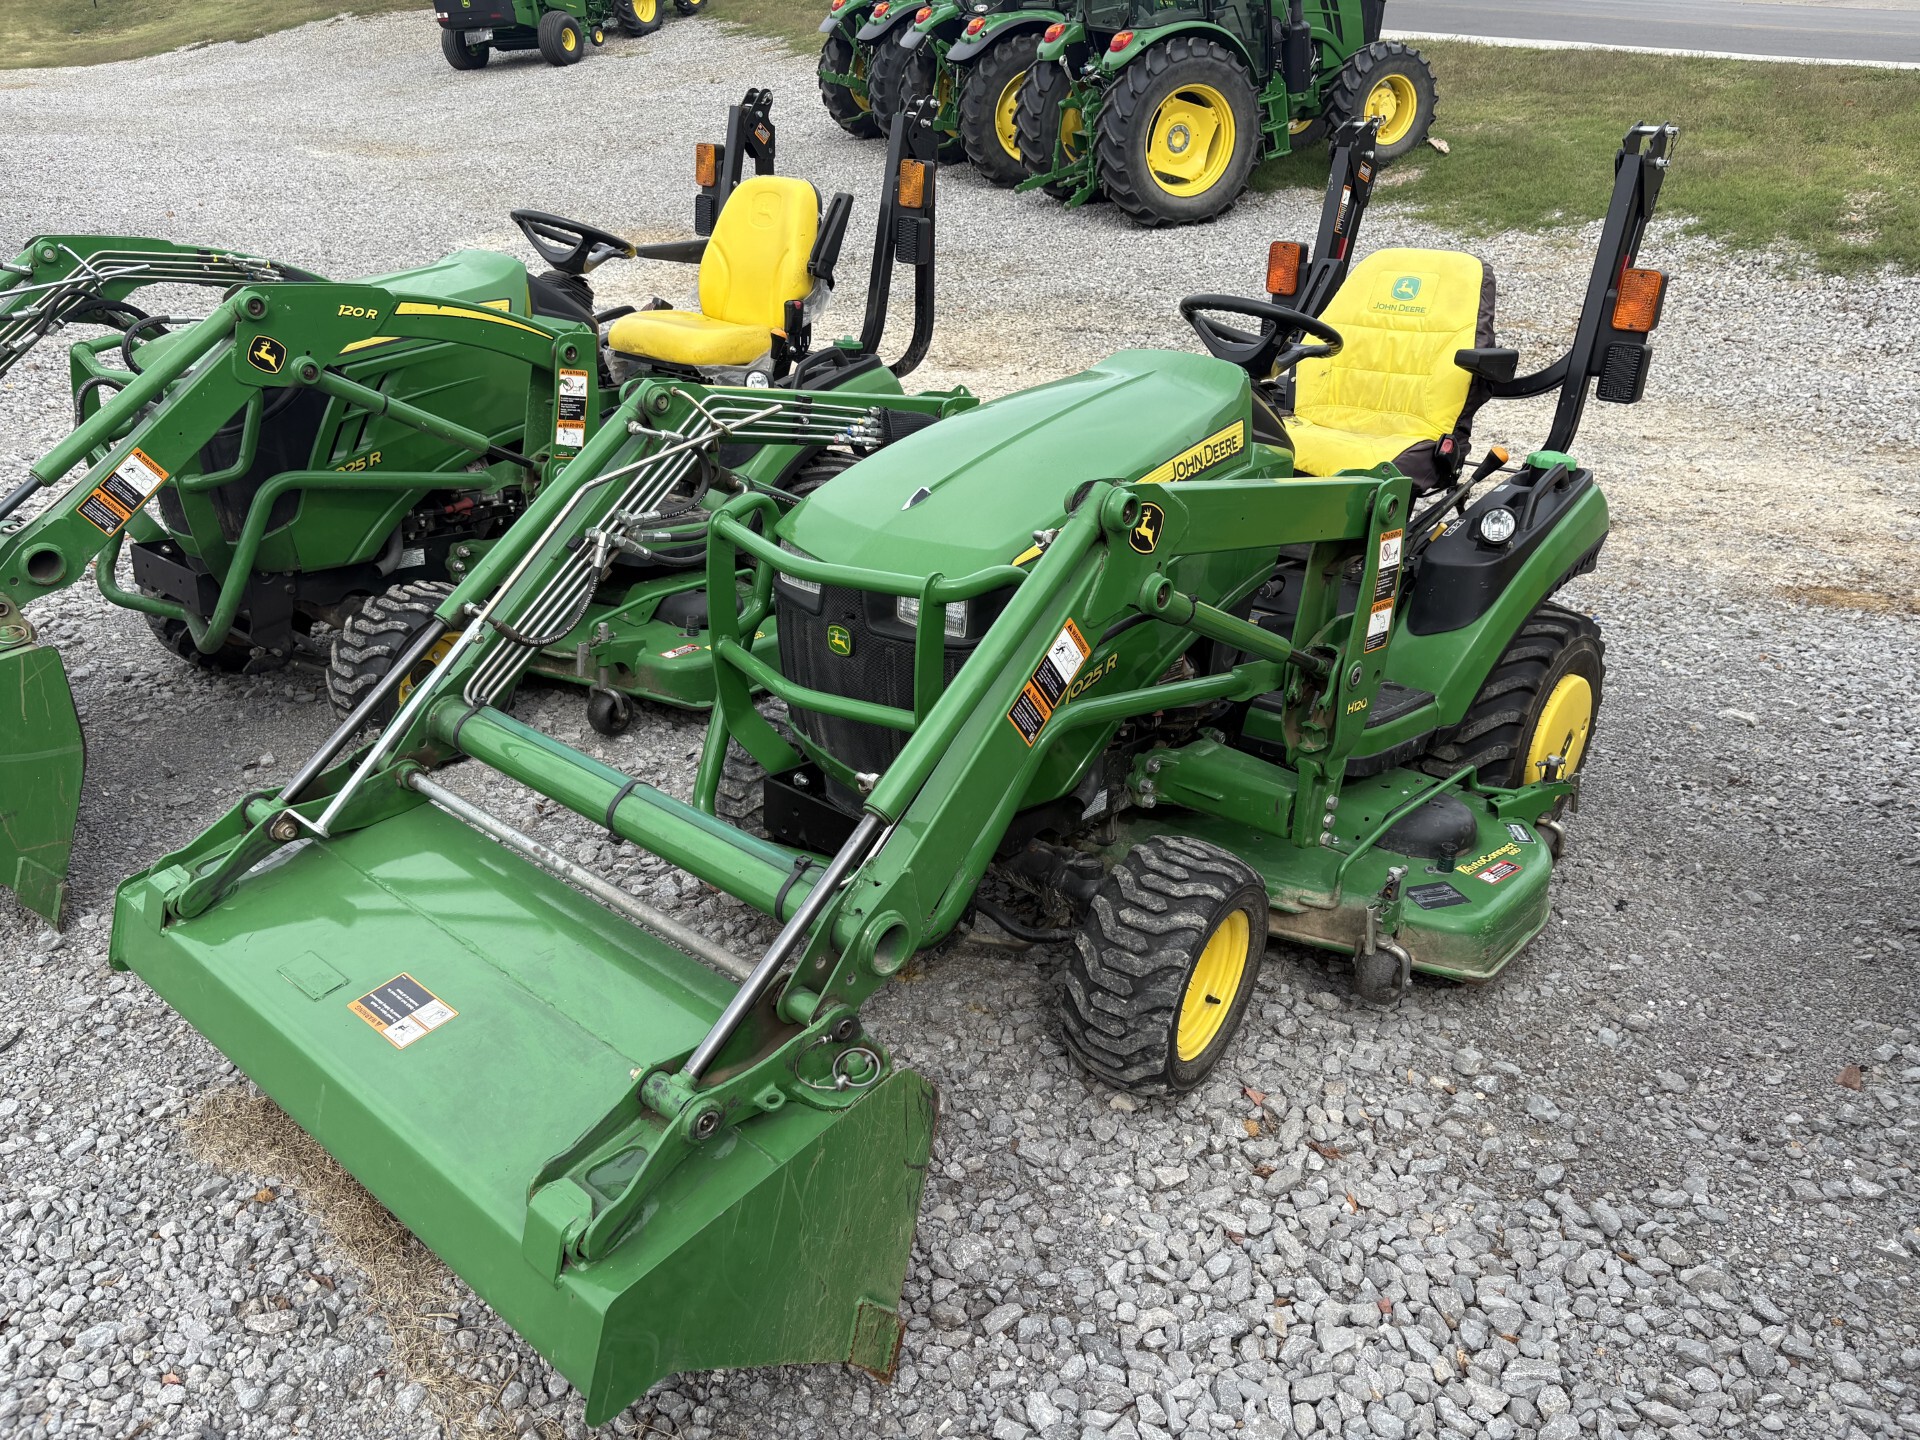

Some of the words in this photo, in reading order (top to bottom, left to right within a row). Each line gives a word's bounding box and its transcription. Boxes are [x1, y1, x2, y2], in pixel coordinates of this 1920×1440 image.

[338, 304, 365, 317] 120
[365, 308, 379, 320] R
[1372, 301, 1397, 311] JOHN
[1397, 303, 1427, 314] DEERE
[564, 369, 587, 377] WARNING
[141, 454, 164, 477] WARNING
[369, 451, 382, 467] R
[1170, 452, 1204, 482] JOHN
[1203, 435, 1239, 464] DEERE
[102, 496, 126, 518] WARNING
[1071, 630, 1088, 655] WARNING
[1065, 662, 1105, 705] 1025
[1105, 652, 1119, 675] R
[1031, 692, 1048, 718] WARNING
[1461, 842, 1518, 875] AutoConnect
[355, 1004, 378, 1023] WARNING
